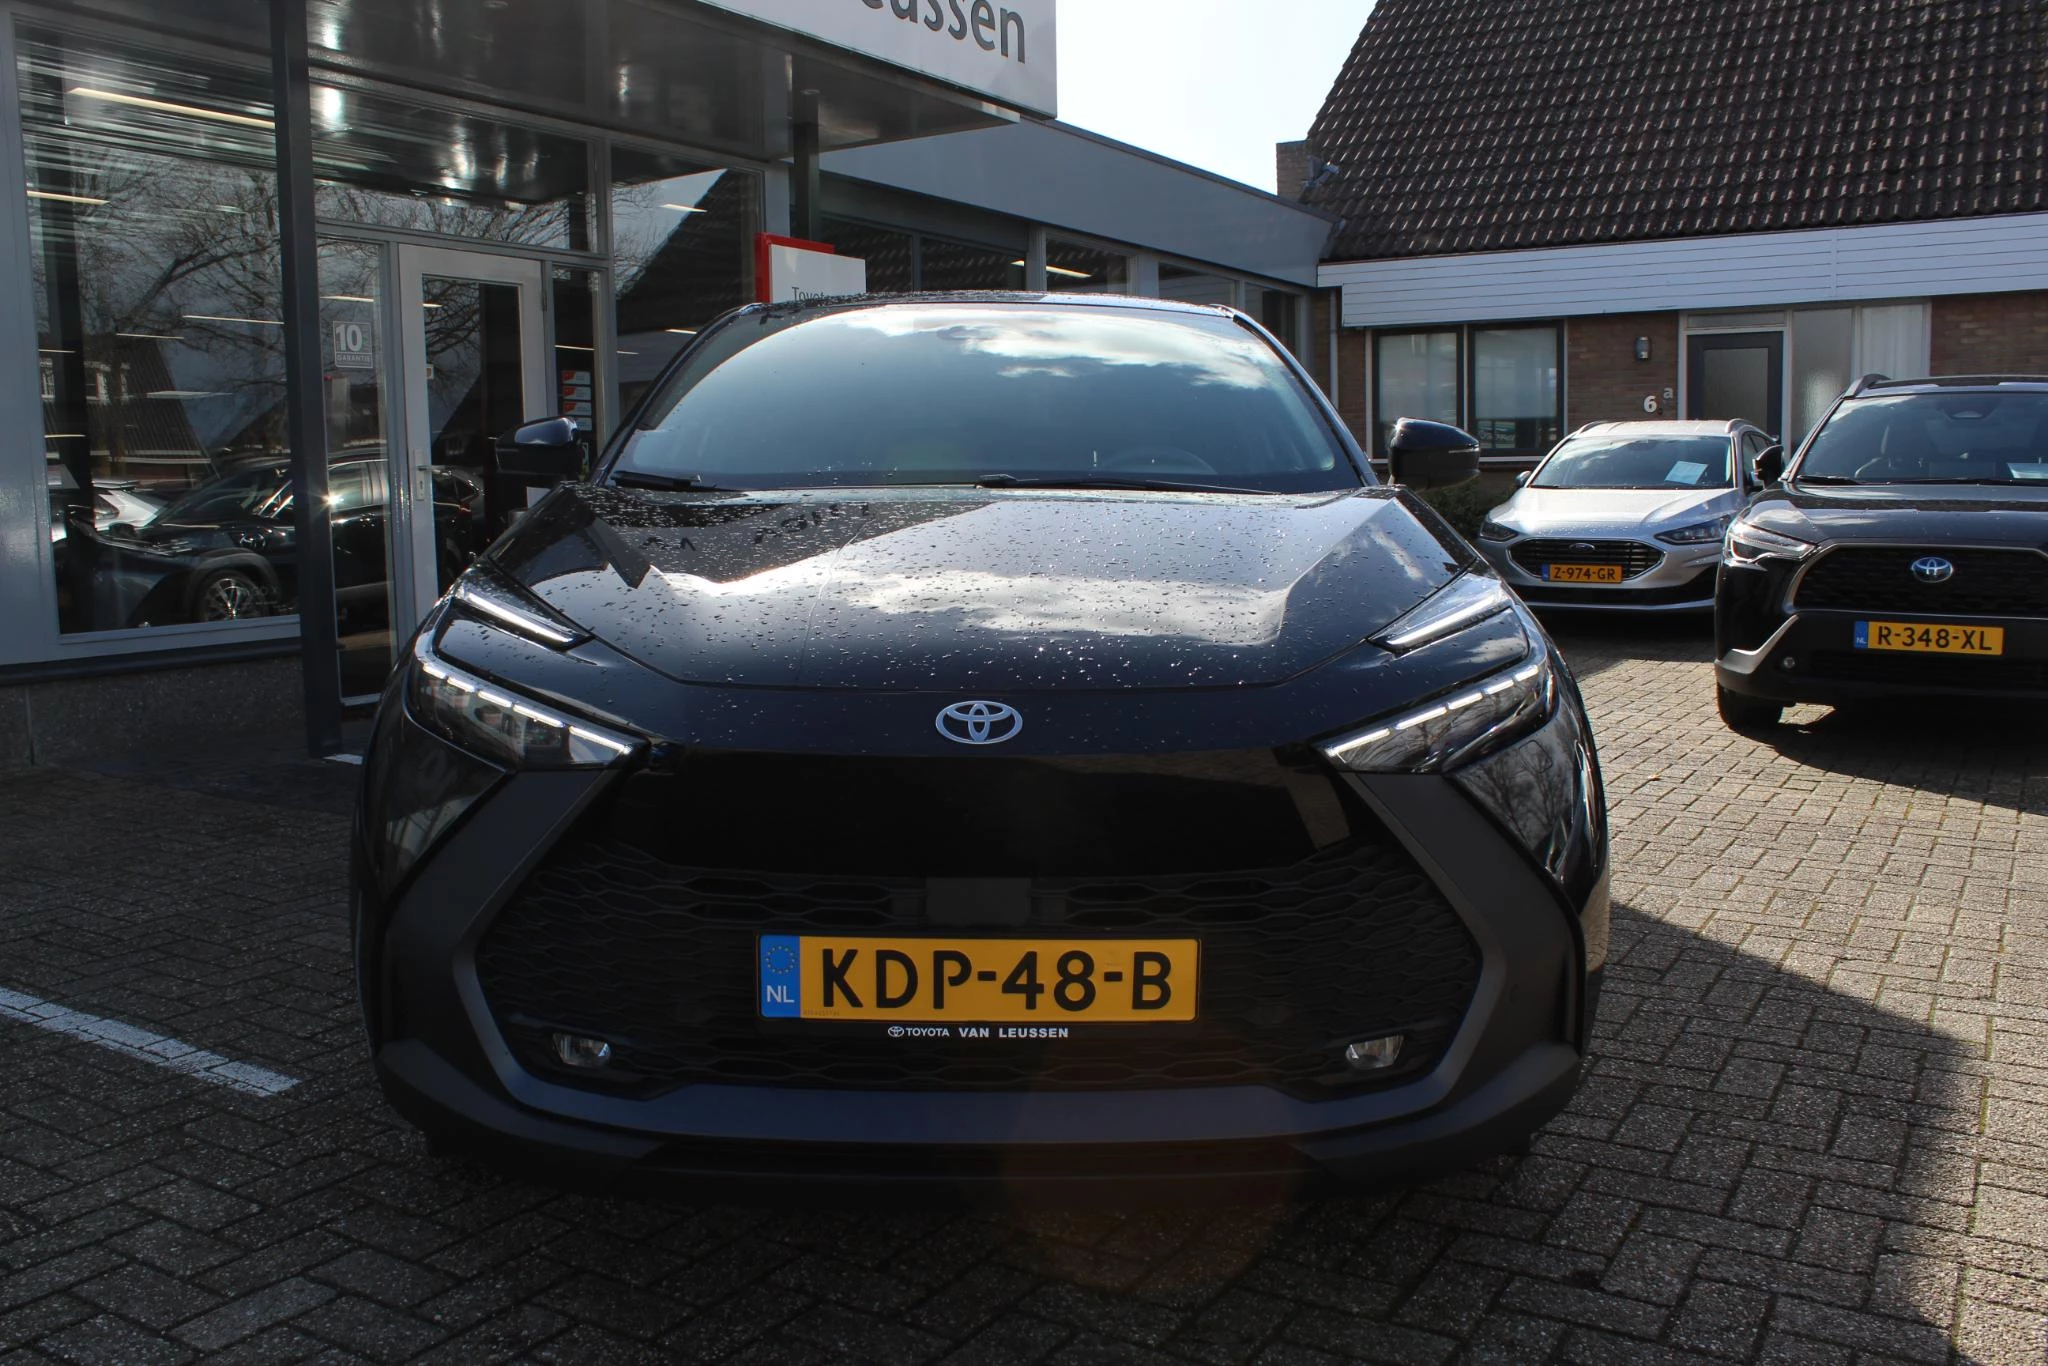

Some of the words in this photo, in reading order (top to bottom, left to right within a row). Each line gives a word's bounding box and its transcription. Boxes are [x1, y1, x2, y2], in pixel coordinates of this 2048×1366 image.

[862, 0, 1025, 64] ussen
[791, 286, 826, 301] Toyot
[335, 324, 362, 351] 10
[1643, 395, 1657, 412] 6
[1663, 387, 1674, 399] a
[1553, 567, 1616, 580] Z-974-GR
[1878, 626, 1992, 650] R-348-XL
[766, 985, 795, 1003] NL
[822, 948, 1172, 1012] KDP-48-B
[905, 1028, 950, 1037] TOYOTA
[958, 1028, 990, 1038] VAN
[999, 1028, 1069, 1038] LEUSSEN
